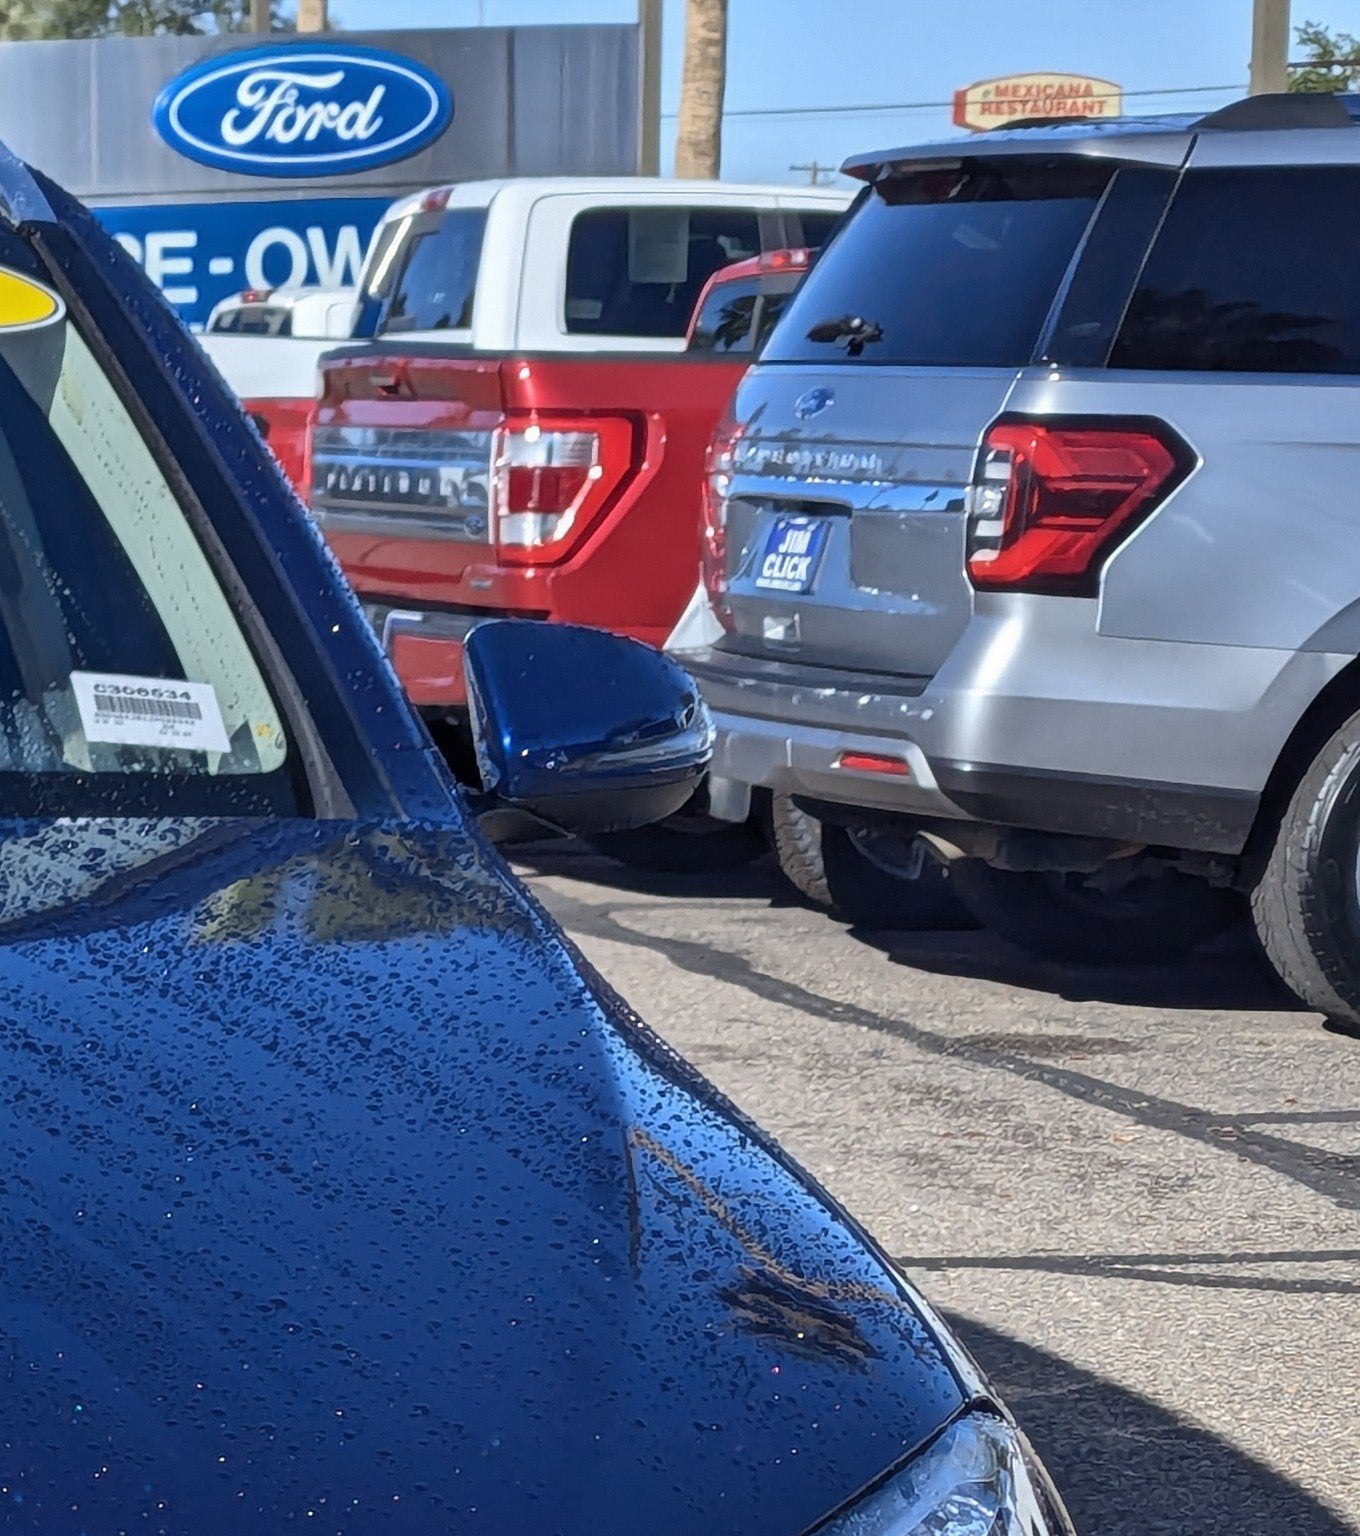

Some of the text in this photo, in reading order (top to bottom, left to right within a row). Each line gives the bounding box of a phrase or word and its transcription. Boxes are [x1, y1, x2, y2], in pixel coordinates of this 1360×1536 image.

[995, 83, 1094, 98] MEXICANA
[221, 70, 385, 146] Ford
[980, 101, 1106, 116] RESTAURANT
[778, 529, 811, 554] JIM
[762, 553, 811, 581] CLICK
